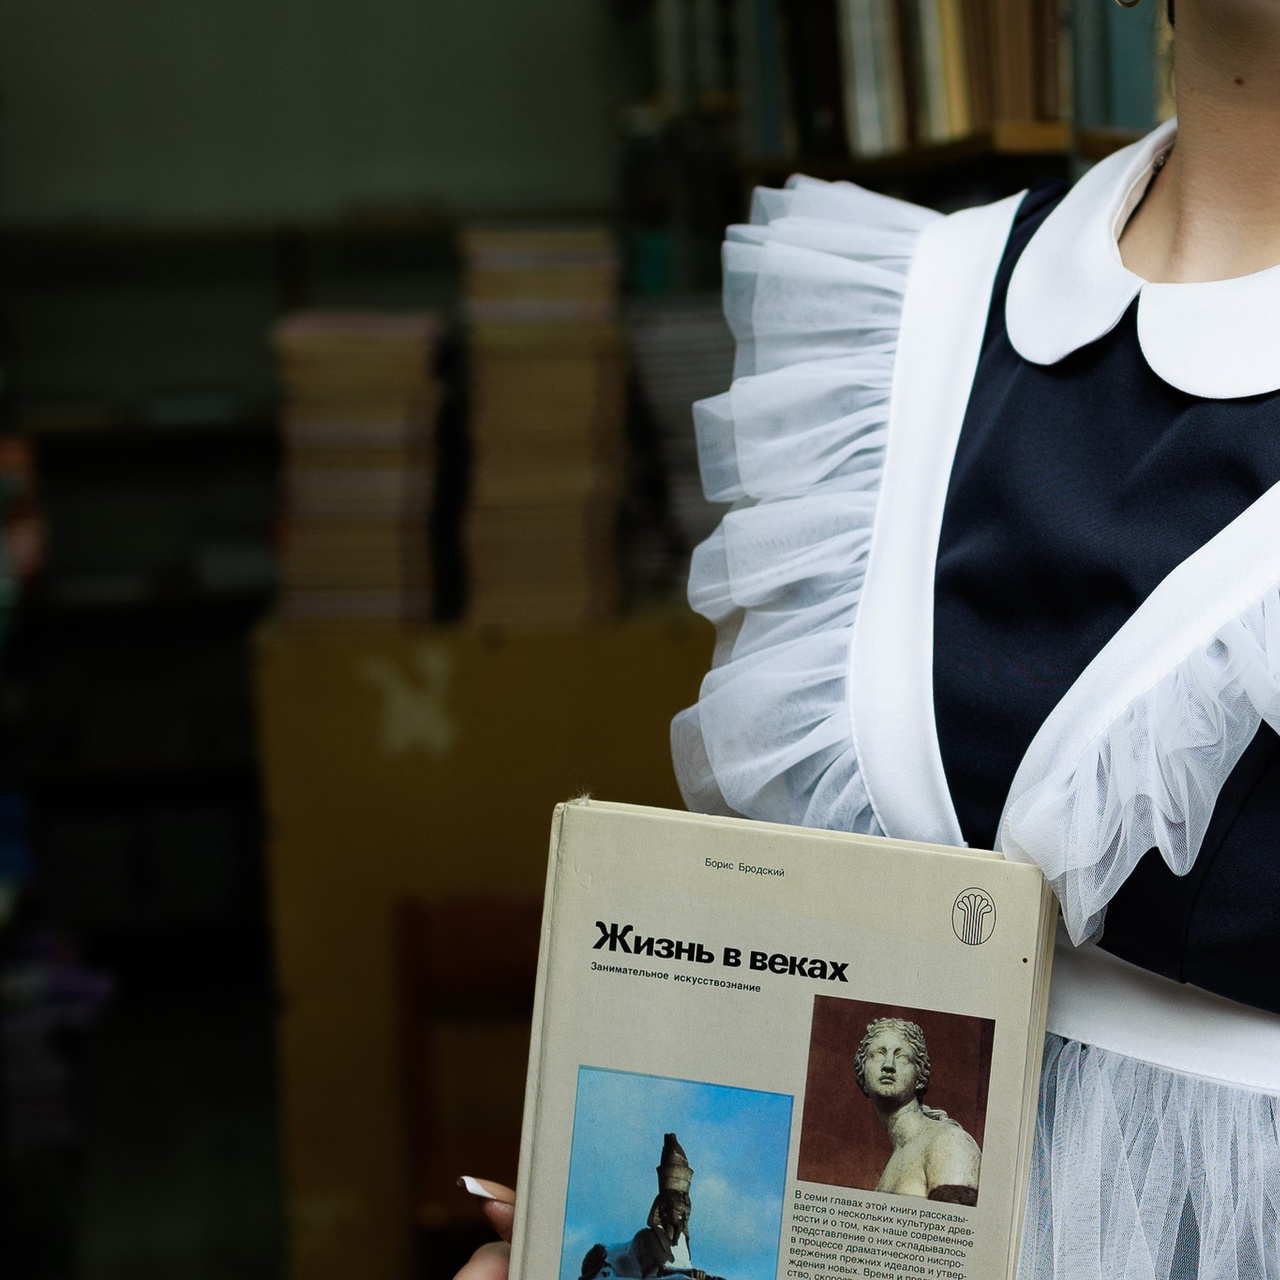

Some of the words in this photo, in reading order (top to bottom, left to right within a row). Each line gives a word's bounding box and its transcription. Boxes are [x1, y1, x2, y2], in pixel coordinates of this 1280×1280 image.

[704, 857, 734, 871] Борис
[738, 861, 785, 878] Бродский
[592, 920, 715, 965] Жизнь
[723, 948, 742, 967] в
[748, 946, 849, 983] веках
[590, 961, 670, 981] Занимательное
[673, 972, 762, 993] искусствознание
[793, 1202, 827, 1214] вается
[828, 1207, 835, 1215] о
[837, 1209, 894, 1224] нескольких
[896, 1217, 946, 1232] культурах
[947, 1225, 974, 1236] древ-
[794, 1189, 802, 1199] В
[803, 1192, 828, 1202] семи
[830, 1196, 863, 1208] главах
[865, 1201, 887, 1211] этой
[889, 1205, 917, 1216] книги
[918, 1210, 968, 1223] рассказы-
[791, 1225, 865, 1242] представление
[867, 1236, 874, 1244] о
[876, 1237, 893, 1246] них
[895, 1240, 966, 1257] складывалось
[792, 1213, 820, 1224] ности
[830, 1219, 837, 1227] о
[862, 1224, 880, 1233] как
[882, 1227, 908, 1237] наше
[910, 1231, 974, 1247] современное
[789, 1247, 837, 1260] вержения
[839, 1254, 881, 1267] прежних
[883, 1261, 925, 1274] идеалов
[936, 1269, 967, 1280] утвер-
[798, 1237, 843, 1250] процессе
[845, 1244, 925, 1262] драматического
[926, 1256, 964, 1268] ниспро-
[788, 1258, 825, 1270] ждения
[862, 1267, 894, 1280] Время
